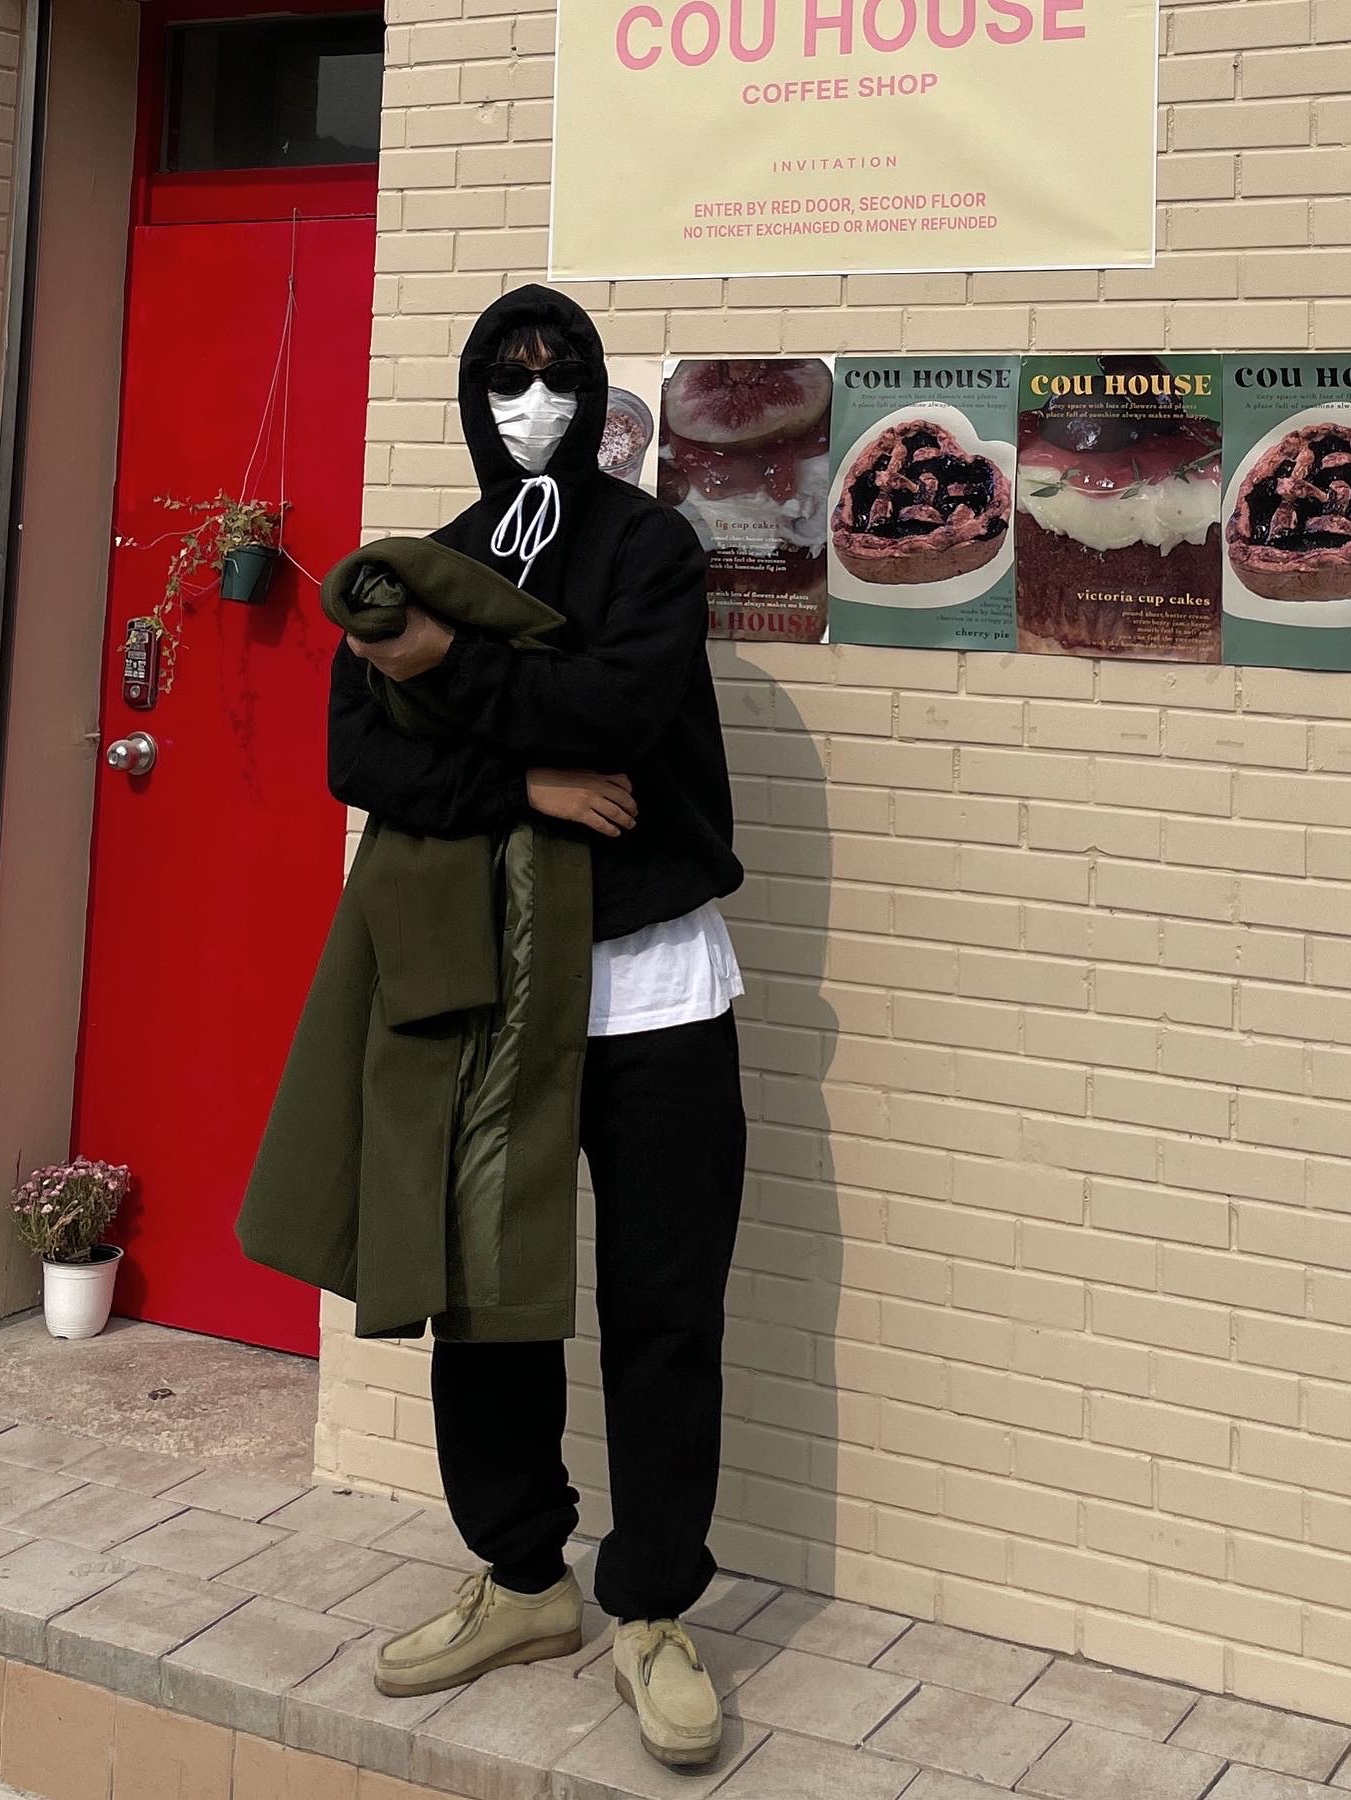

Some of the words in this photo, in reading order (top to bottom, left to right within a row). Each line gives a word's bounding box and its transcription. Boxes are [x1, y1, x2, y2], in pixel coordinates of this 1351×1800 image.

[616, 0, 776, 71] COU
[803, 0, 1086, 58] HOUSE
[742, 79, 849, 104] COFFEE
[858, 73, 938, 98] SHOP
[773, 156, 897, 173] INVITATION
[694, 202, 743, 218] ENTER
[746, 201, 767, 216] BY
[771, 199, 801, 215] RED
[805, 197, 855, 215] DOOR,
[859, 194, 927, 212] SECOND
[931, 192, 986, 209] FLOOR
[683, 226, 703, 240] NO
[707, 224, 753, 238] TICKET
[756, 220, 840, 236] EXCHANGED
[843, 219, 863, 233] OR
[866, 218, 917, 233] MONEY
[921, 215, 998, 231] REFUNDED
[844, 369, 901, 389] COU
[912, 369, 1012, 389] HOUSE
[1030, 374, 1093, 396] COU
[1104, 374, 1212, 396] HOUSE
[1234, 367, 1303, 388] COU
[715, 519, 729, 531] fig
[731, 522, 749, 531] cup
[752, 520, 780, 530] cakes
[1076, 589, 1133, 602] victoria
[1138, 595, 1164, 606] cup
[1169, 593, 1211, 606] cakes
[728, 611, 820, 633] HOUSE
[955, 628, 989, 640] cherry
[994, 630, 1010, 640] pie
